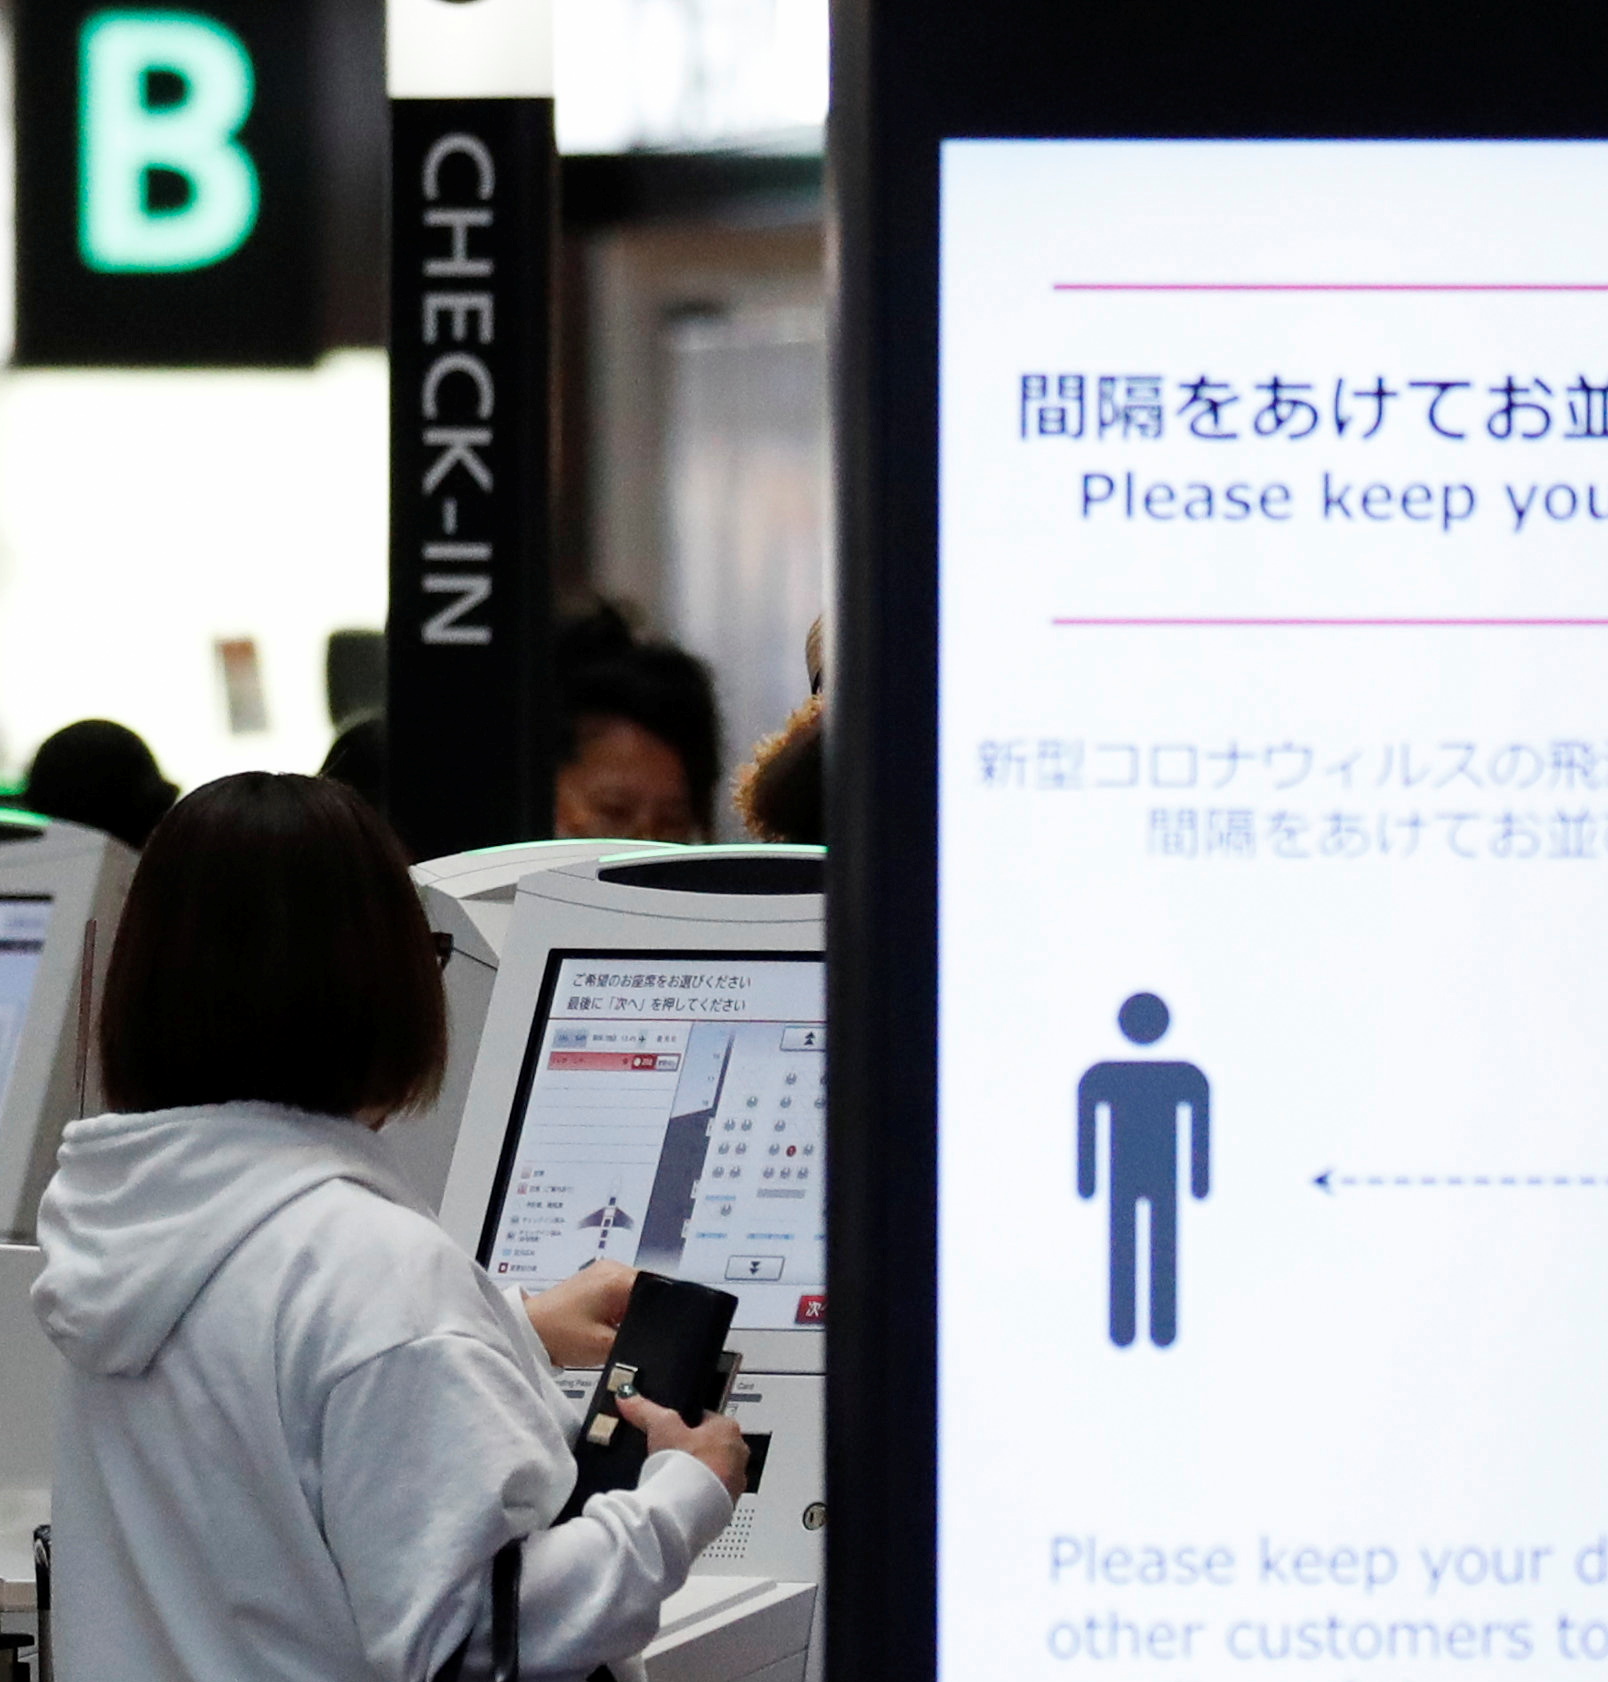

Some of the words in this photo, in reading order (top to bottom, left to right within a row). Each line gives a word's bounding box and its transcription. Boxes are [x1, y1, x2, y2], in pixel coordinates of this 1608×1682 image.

[77, 10, 260, 274] B
[421, 132, 496, 646] CHECK-IN
[1079, 470, 1293, 522] Please
[1321, 470, 1477, 533] keep
[805, 1299, 829, 1317] 次
[1048, 1533, 1236, 1586] Please
[1259, 1535, 1400, 1593] keep
[1419, 1544, 1554, 1594] your
[1045, 1612, 1204, 1661] other
[1225, 1614, 1536, 1662] customers
